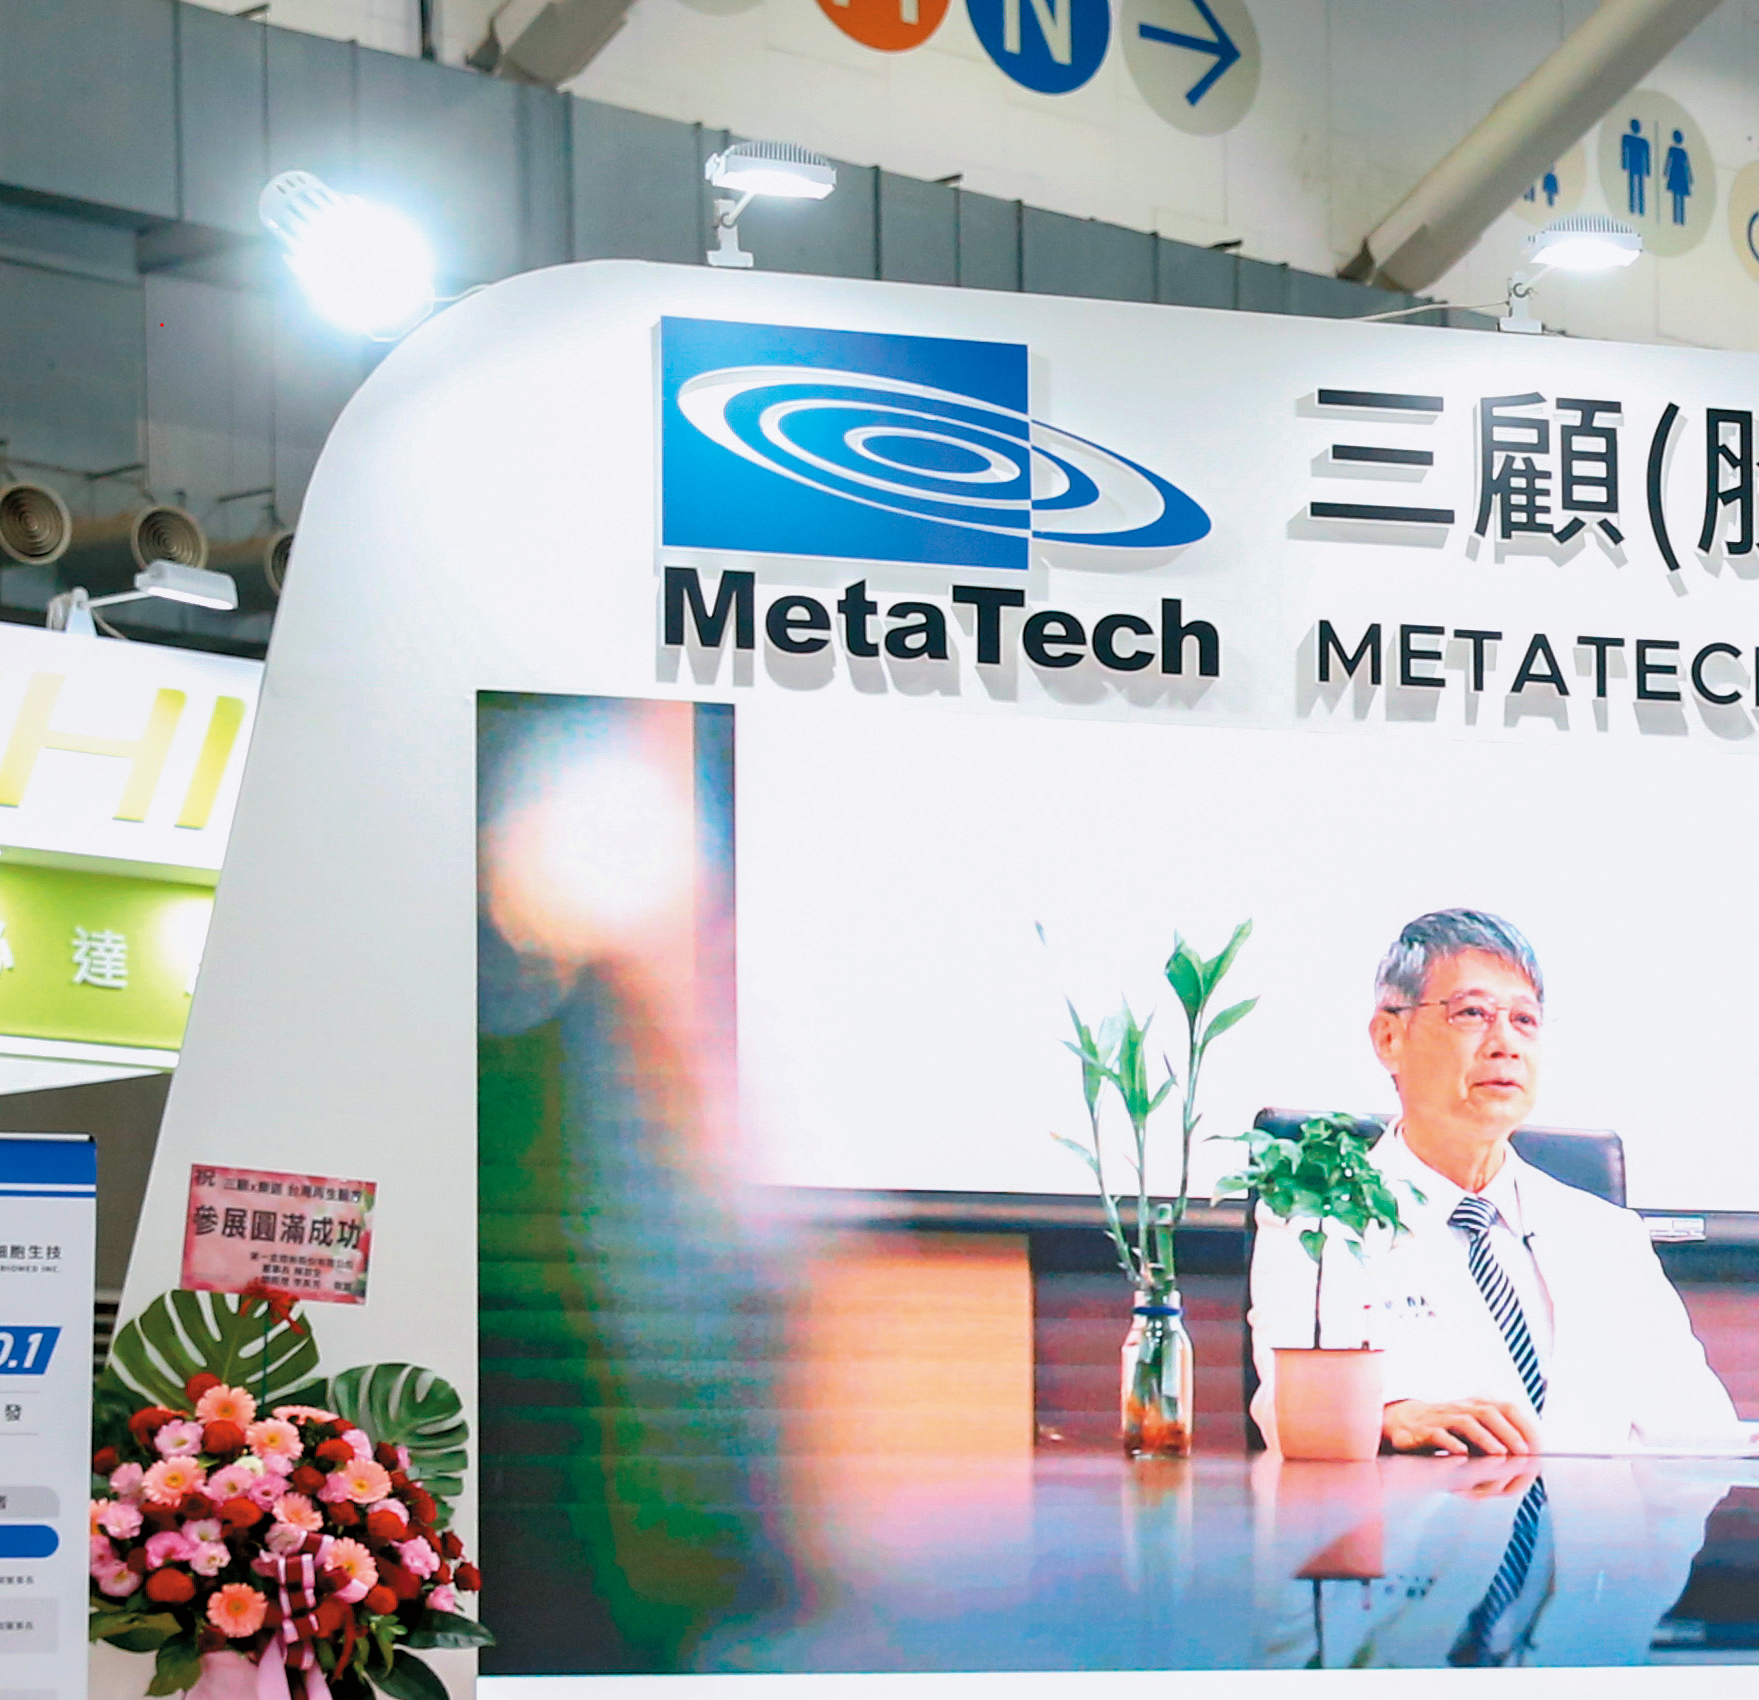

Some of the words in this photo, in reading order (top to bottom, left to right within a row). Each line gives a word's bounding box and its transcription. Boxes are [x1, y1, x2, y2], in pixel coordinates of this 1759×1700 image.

[663, 566, 1221, 679] MetaTech
[193, 1205, 362, 1249] 參展圓滿成功
